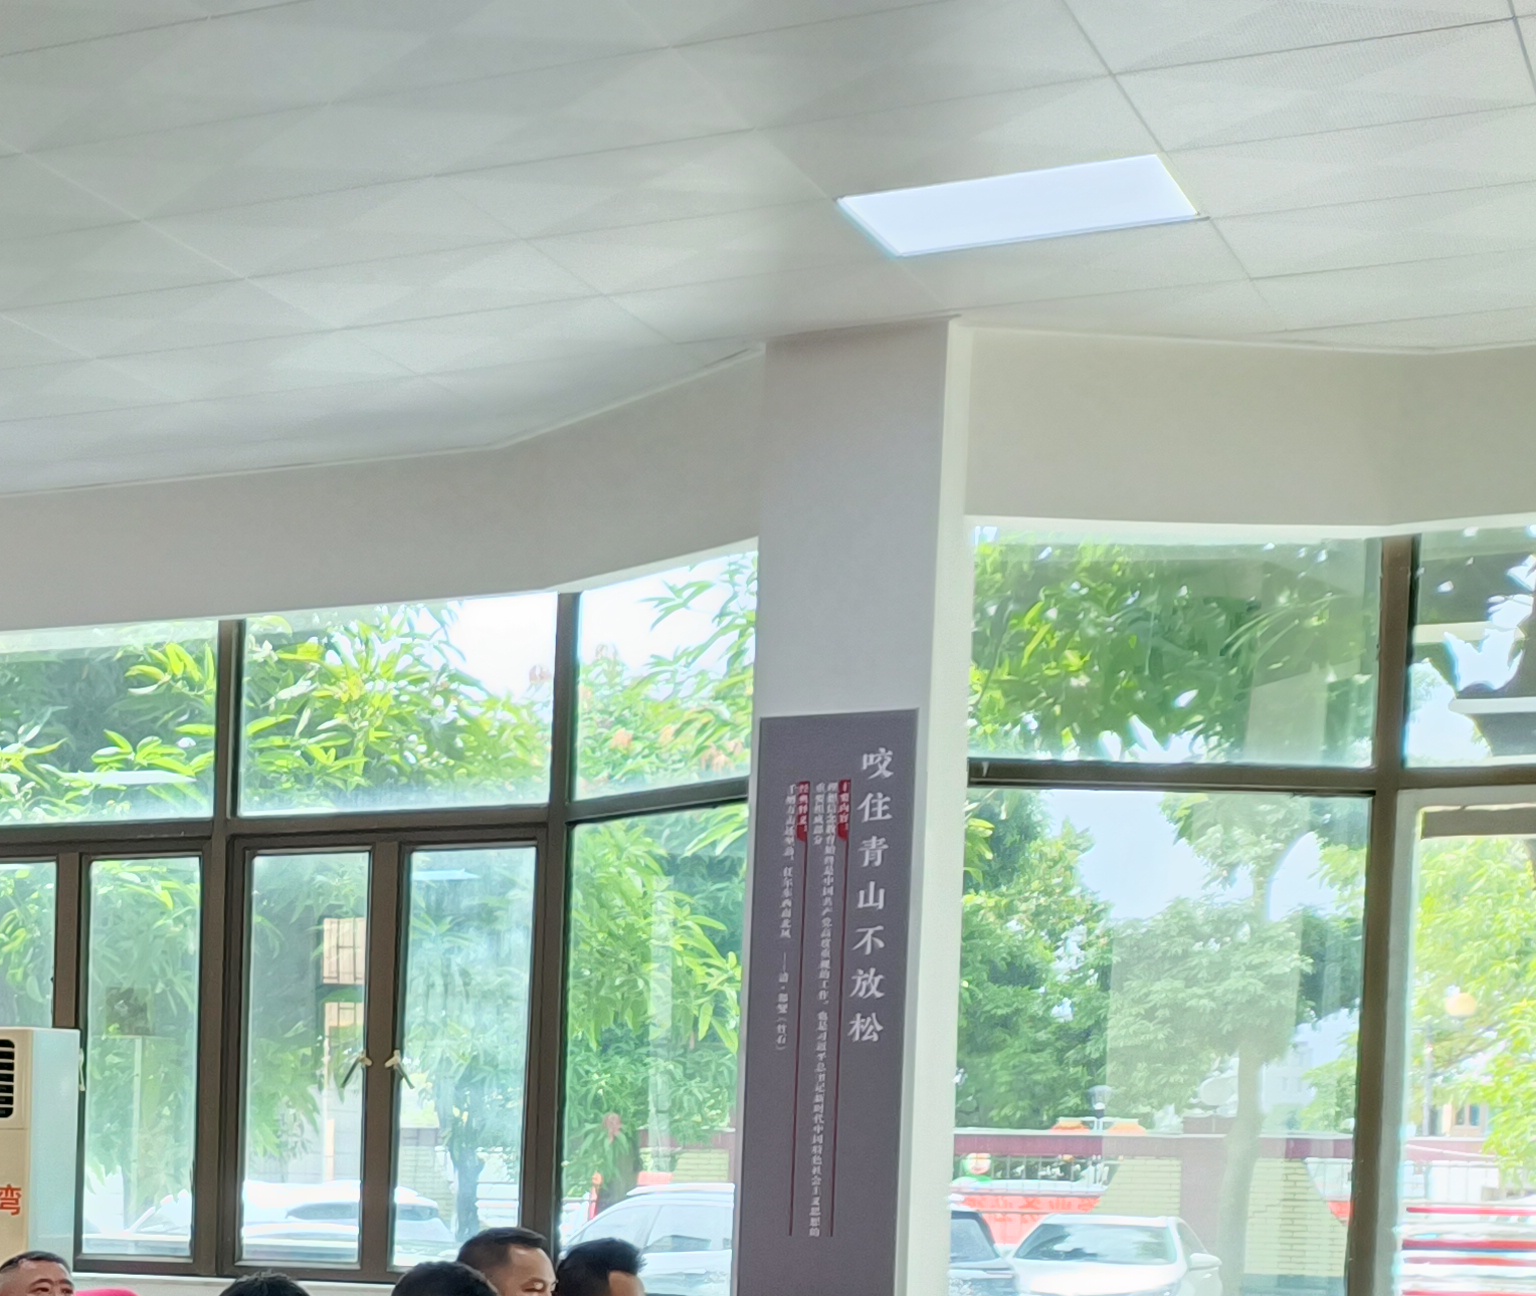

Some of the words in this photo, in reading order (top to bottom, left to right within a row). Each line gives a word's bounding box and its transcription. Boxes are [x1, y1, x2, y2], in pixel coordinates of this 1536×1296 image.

[848, 747, 894, 1043] 咬住青山不放松
